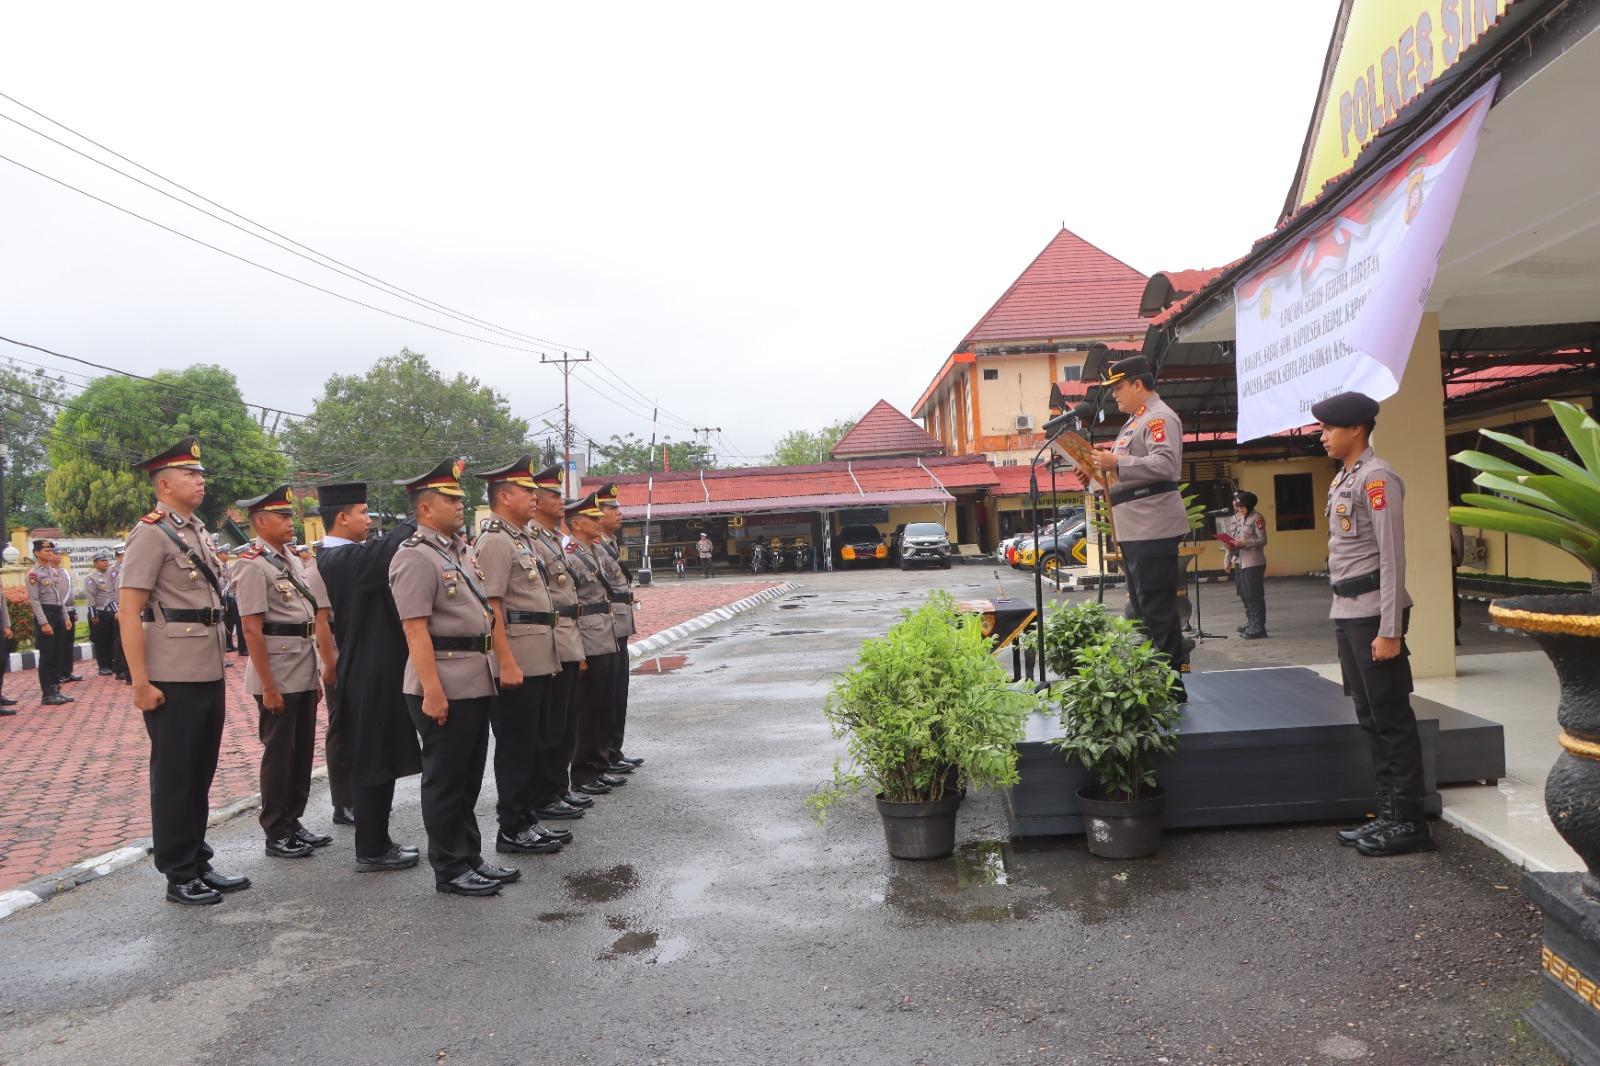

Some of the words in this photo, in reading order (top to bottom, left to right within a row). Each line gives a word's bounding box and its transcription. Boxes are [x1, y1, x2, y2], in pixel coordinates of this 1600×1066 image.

[1340, 11, 1433, 158] POLRES
[1325, 272, 1348, 300] TERIMA
[1350, 254, 1380, 288] JABATAN
